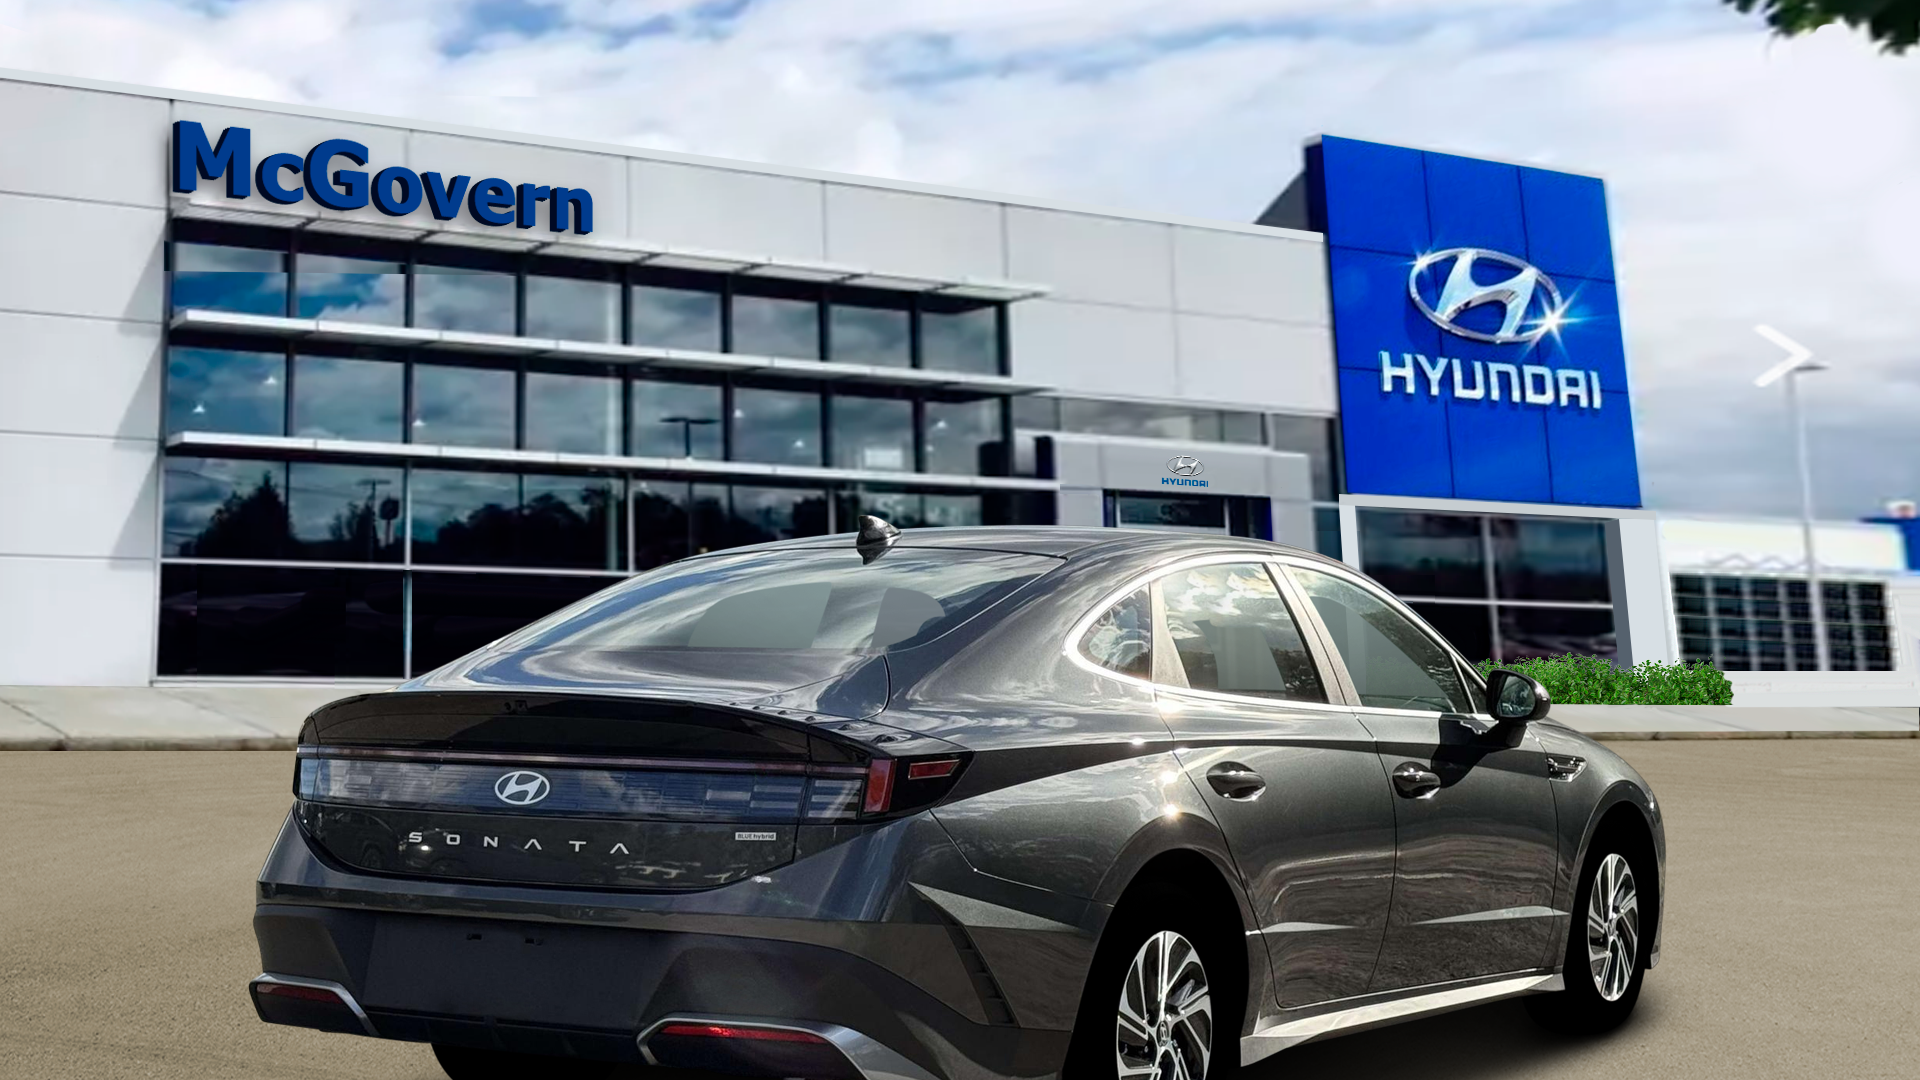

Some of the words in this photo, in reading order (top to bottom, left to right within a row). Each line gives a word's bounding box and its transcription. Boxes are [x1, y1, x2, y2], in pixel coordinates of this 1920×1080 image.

[172, 119, 594, 235] McGovern
[1379, 350, 1602, 409] HYUNDAI
[1161, 477, 1209, 488] HYUNDAI
[408, 831, 630, 855] SONATA
